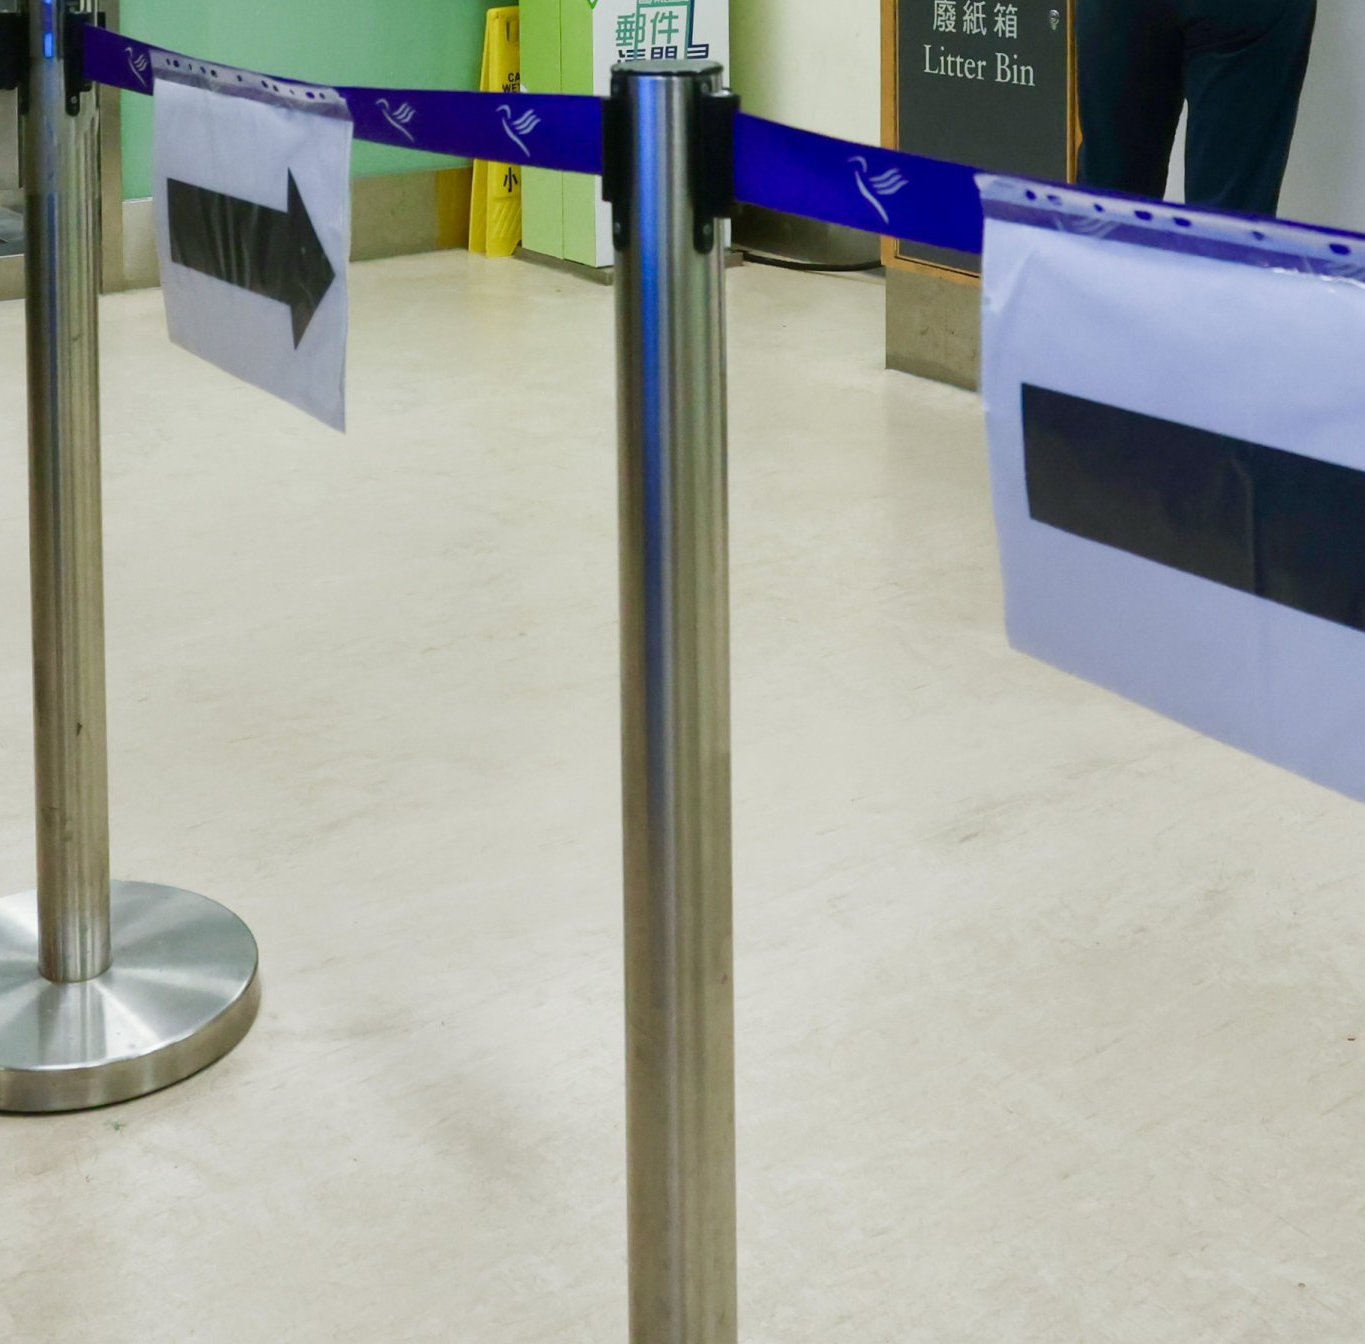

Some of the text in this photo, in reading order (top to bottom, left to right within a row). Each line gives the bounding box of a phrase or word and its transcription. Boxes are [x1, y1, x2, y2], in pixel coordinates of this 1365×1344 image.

[616, 10, 679, 47] 郵件
[924, 44, 1036, 87] Litter Bin
